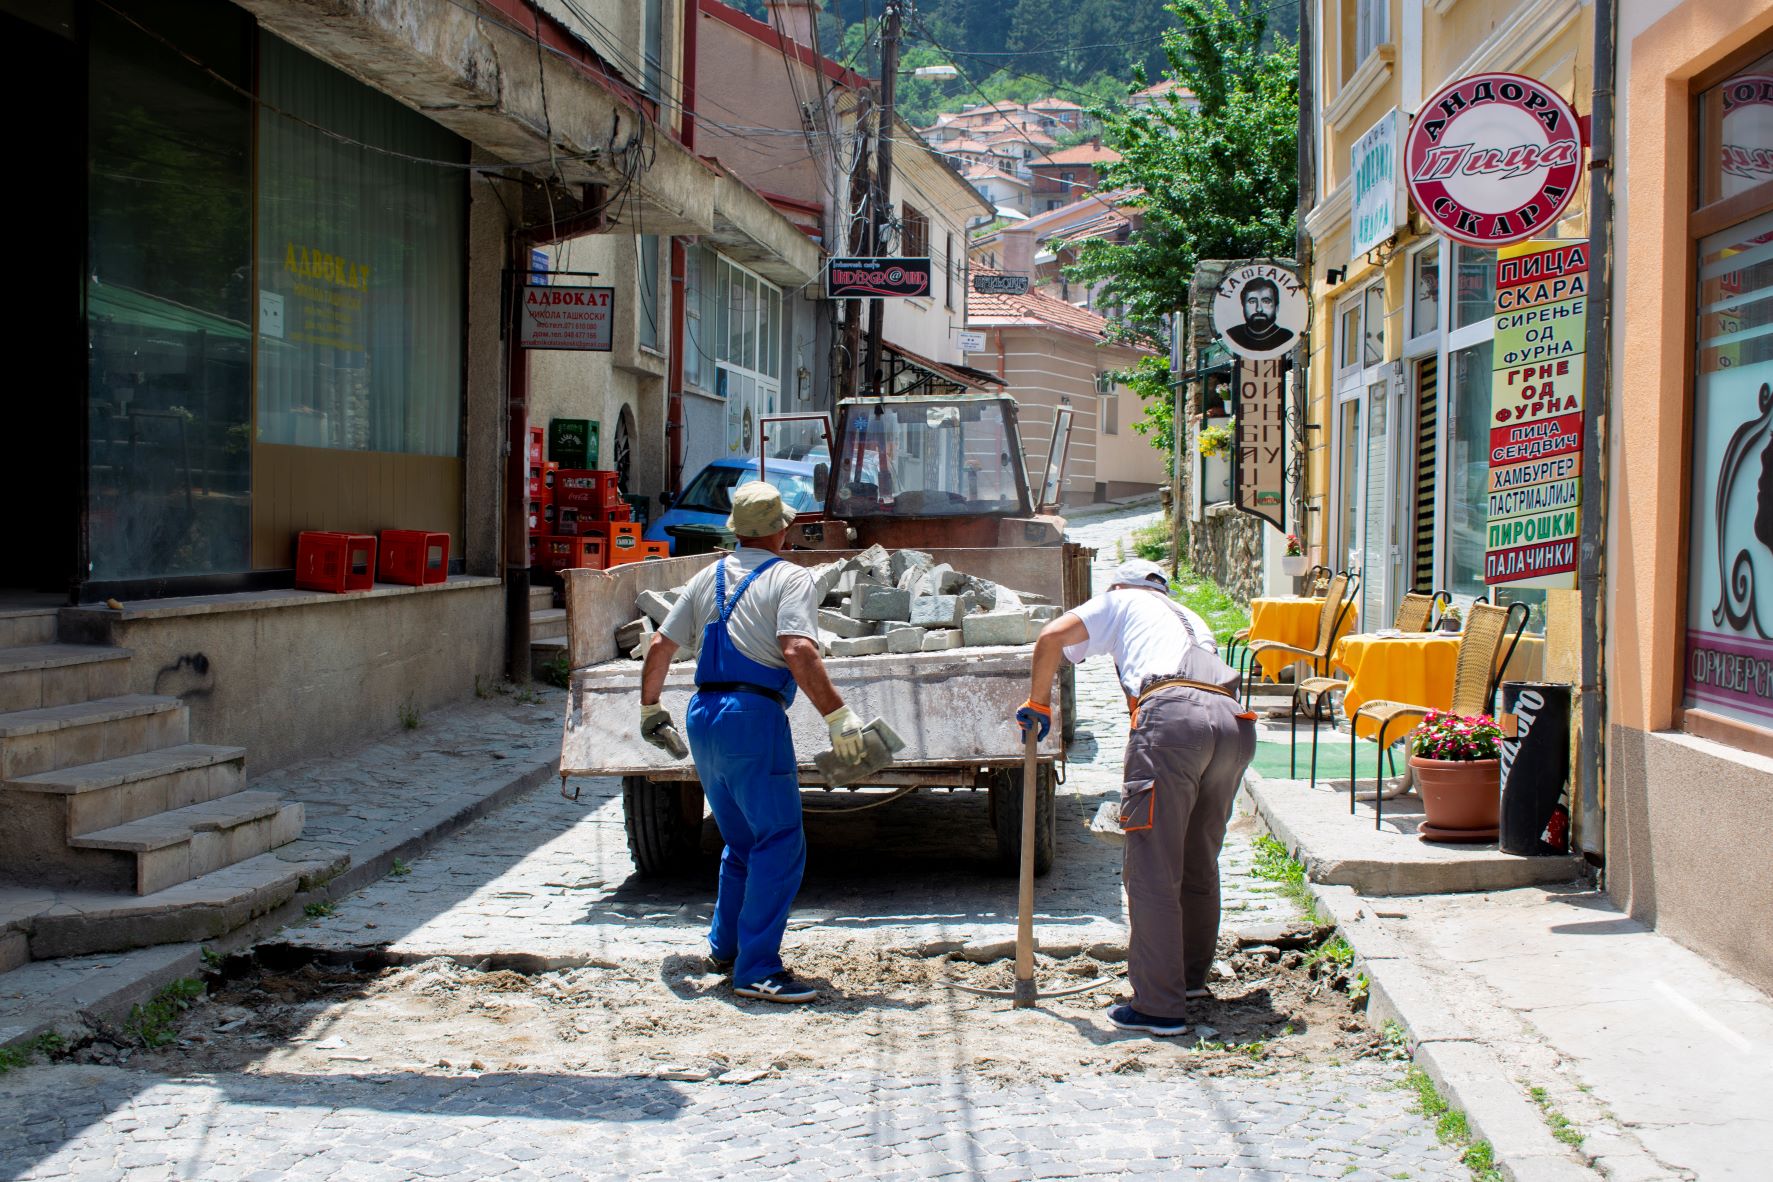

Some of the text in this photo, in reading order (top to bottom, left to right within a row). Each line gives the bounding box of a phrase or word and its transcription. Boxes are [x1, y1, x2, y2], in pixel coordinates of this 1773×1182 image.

[1424, 82, 1560, 142] АНДОРА
[1413, 140, 1577, 182] Пица
[1433, 185, 1566, 236] СКАРА
[284, 241, 369, 292] АДВОКАТ
[1500, 248, 1585, 282] ПИЦА
[1219, 266, 1299, 299] КАФЕАНА
[1498, 276, 1585, 309] СКАРА
[527, 291, 609, 306] АДВОКАТ
[529, 311, 605, 320] НИКОЛА ТАШКОСКИ
[1497, 302, 1583, 330] СИРЕЊЕ
[1525, 326, 1554, 342] ОД
[1503, 340, 1573, 364] ФУРНА
[1507, 361, 1569, 385] ГРНЕ
[1521, 381, 1555, 400] ОД
[1495, 395, 1577, 422] ФУРНА
[1511, 422, 1560, 441] ПИЦА
[1493, 434, 1577, 461] СЕНДВИЧ
[1494, 458, 1574, 488] ХАМБУРГЕР
[1489, 480, 1576, 516] ПАСТРМАЈЛИЈА
[1489, 511, 1575, 548] ПИРОШКИ
[1487, 542, 1574, 578] ПАЛАЧИНКИ
